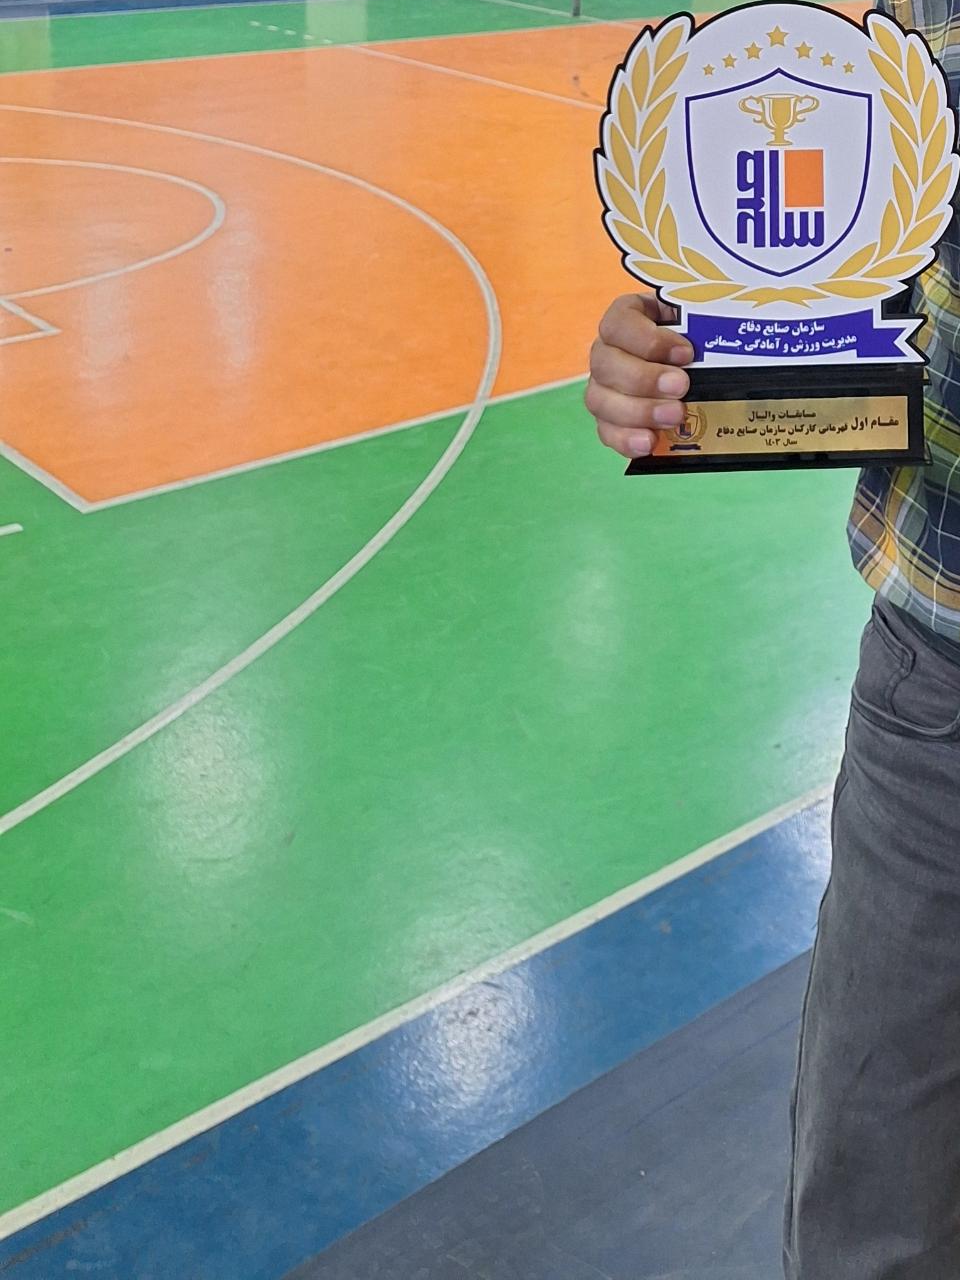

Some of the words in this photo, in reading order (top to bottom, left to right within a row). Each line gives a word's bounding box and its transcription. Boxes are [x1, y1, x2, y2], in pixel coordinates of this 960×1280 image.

[738, 321, 761, 335] دفاع
[763, 322, 790, 336] صنایع
[791, 321, 825, 336] سازمان
[704, 335, 743, 351] جسمانی
[744, 337, 781, 352] آمادگی
[783, 343, 789, 353] و
[790, 339, 820, 353] ورزش
[822, 335, 857, 349] مدیریت
[778, 409, 817, 419] مسابقات
[819, 423, 848, 434] قهرمانی
[851, 417, 868, 431] اول
[870, 416, 899, 429] مقام
[716, 426, 735, 438] دفاع
[736, 425, 758, 437] صنایع
[759, 424, 787, 436] سازمان
[788, 424, 817, 435] کارکنان
[783, 438, 798, 447] سال
